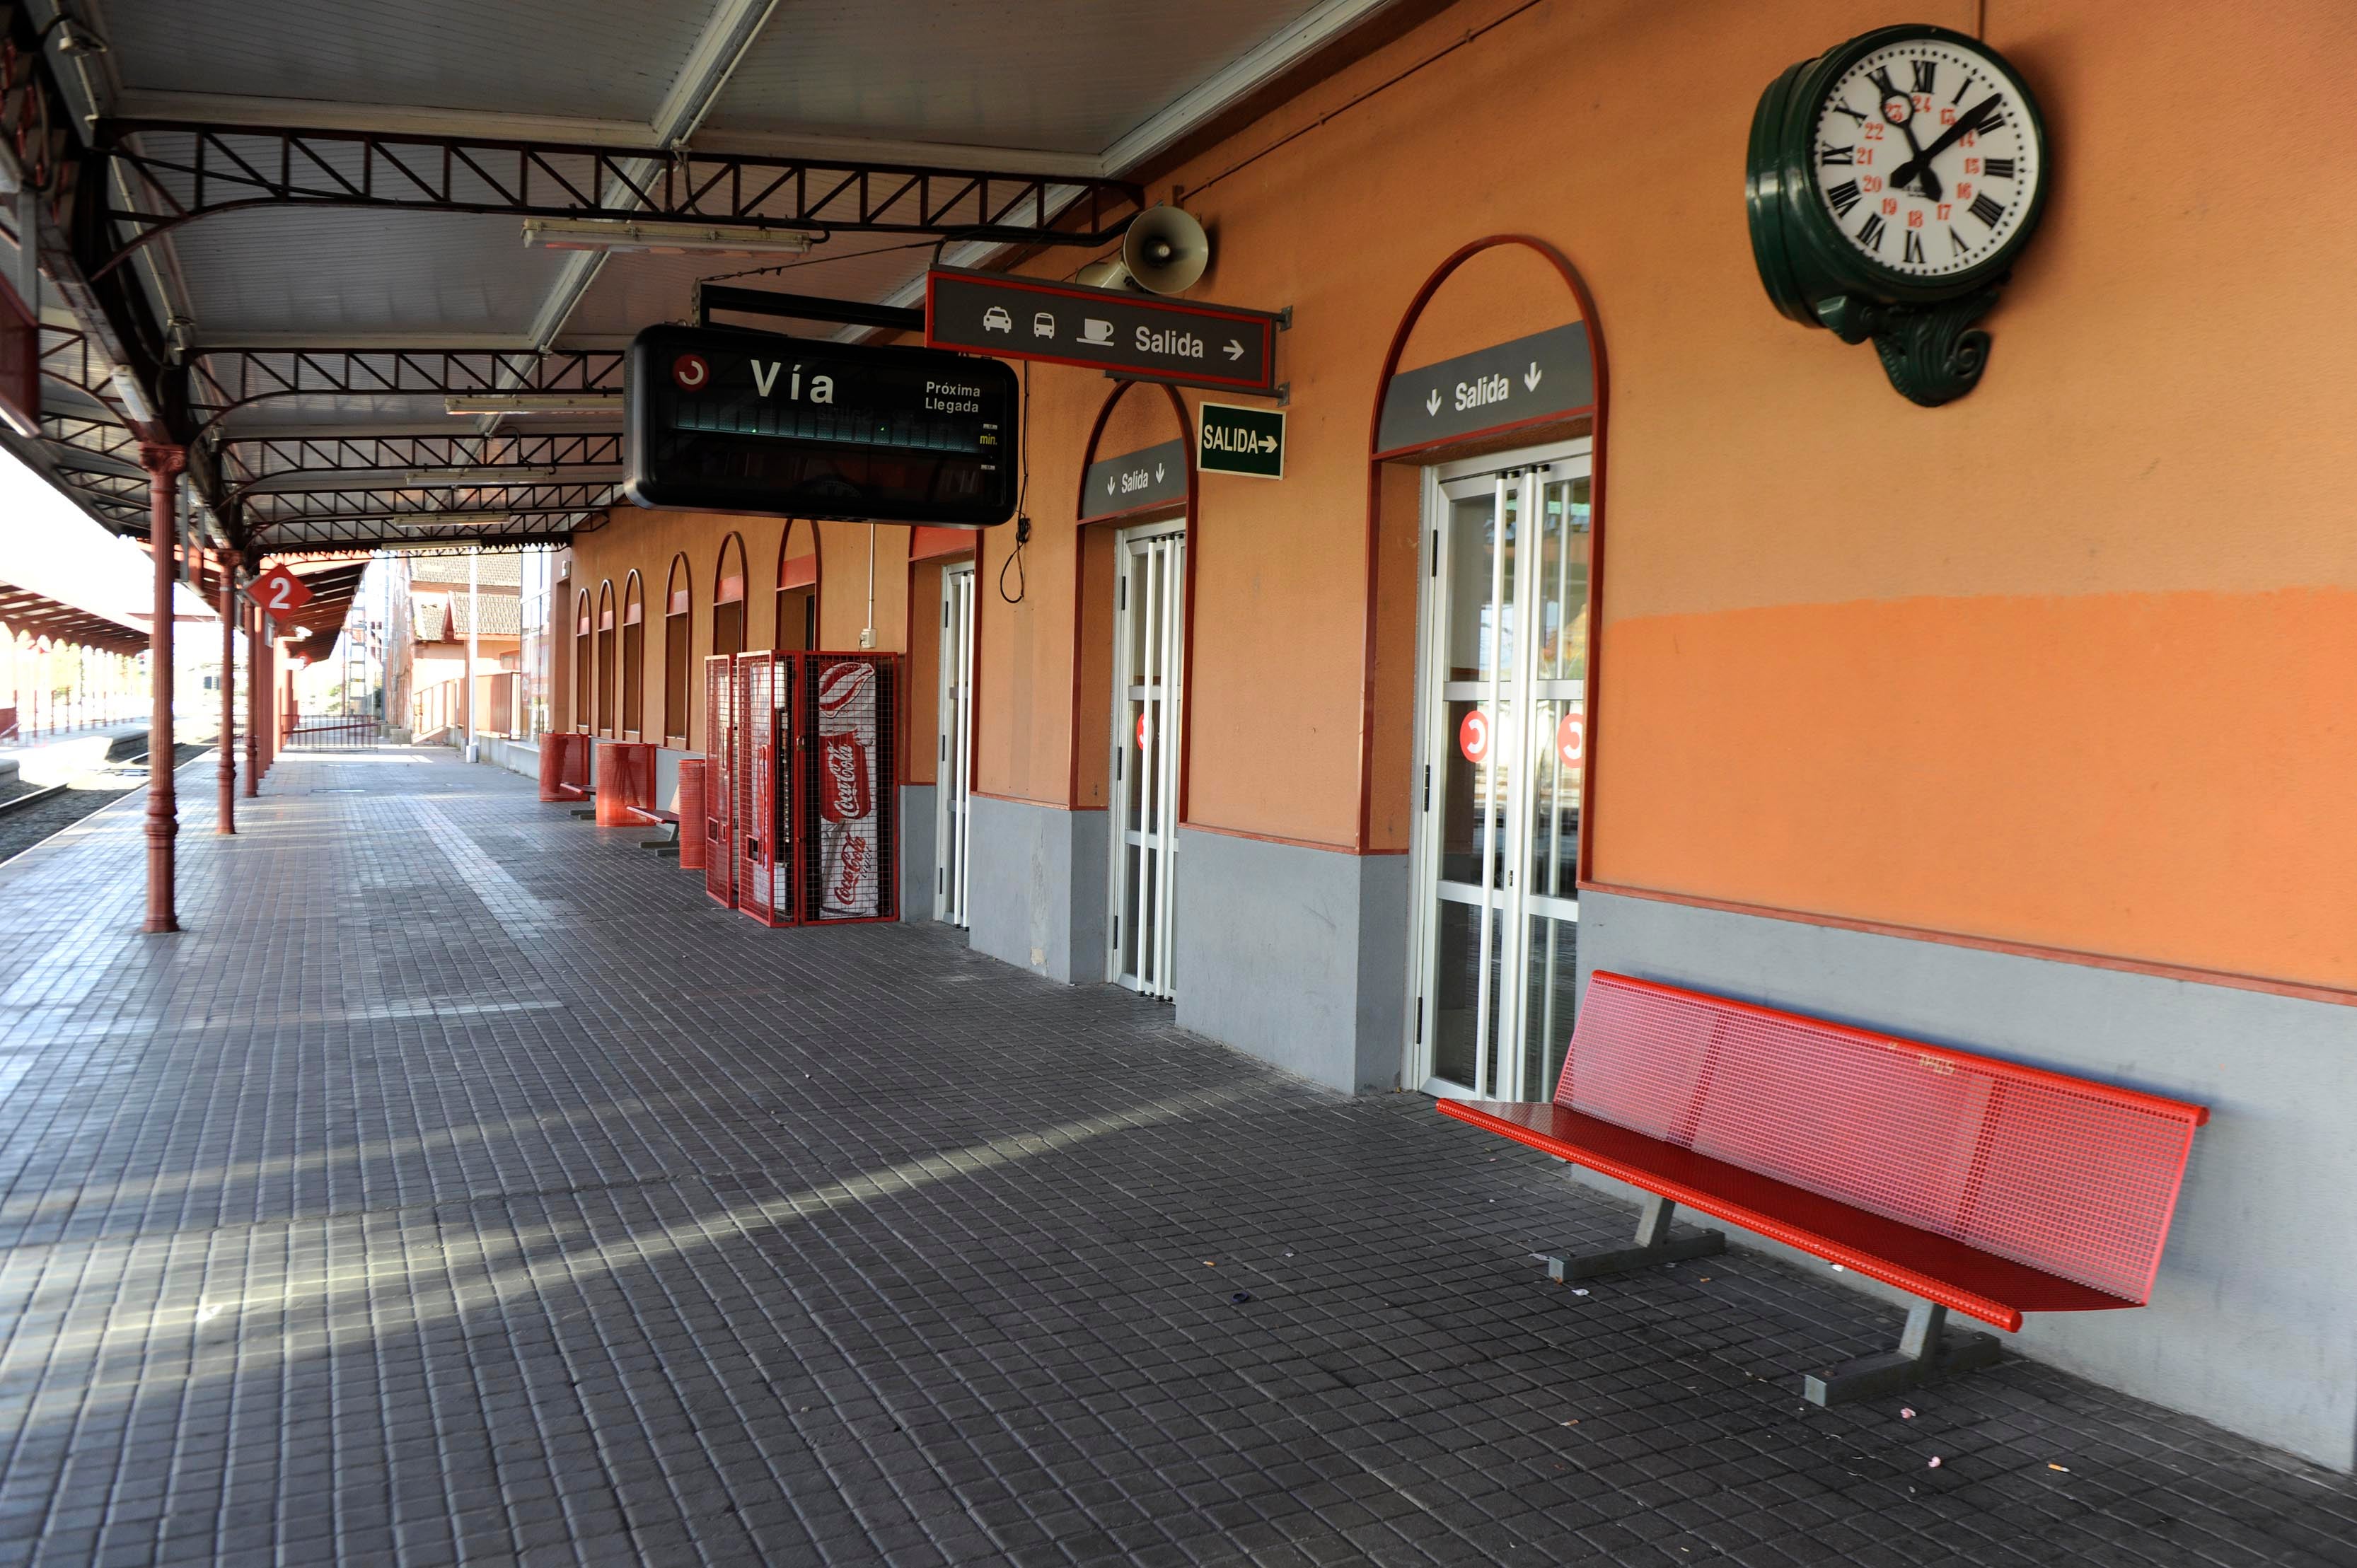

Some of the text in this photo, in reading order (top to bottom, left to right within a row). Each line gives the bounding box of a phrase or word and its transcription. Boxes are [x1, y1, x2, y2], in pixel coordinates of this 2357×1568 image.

[1911, 60, 1938, 94] XII
[1832, 96, 1867, 129] X
[1885, 103, 1904, 122] 23
[1912, 95, 1932, 112] 24
[1940, 108, 1957, 126] 13
[1864, 122, 1884, 140] 22
[1822, 141, 1855, 167] IX
[1857, 146, 1873, 165] 21
[1965, 157, 1980, 174] 15
[1984, 156, 2015, 180] III
[1863, 174, 1882, 192] 20
[1957, 182, 1972, 199] 16
[1882, 198, 1897, 215] 19
[1937, 203, 1952, 221] 17
[1908, 210, 1923, 228] 18
[1949, 225, 1970, 257] V
[1135, 326, 1204, 359] Salida
[750, 359, 834, 404] Vía
[926, 381, 981, 397] Próxima
[1455, 373, 1510, 412] Salida
[925, 397, 980, 413] Llegada
[1203, 424, 1259, 455] SALIDA
[1121, 469, 1149, 494] Salida
[270, 577, 290, 609] 2
